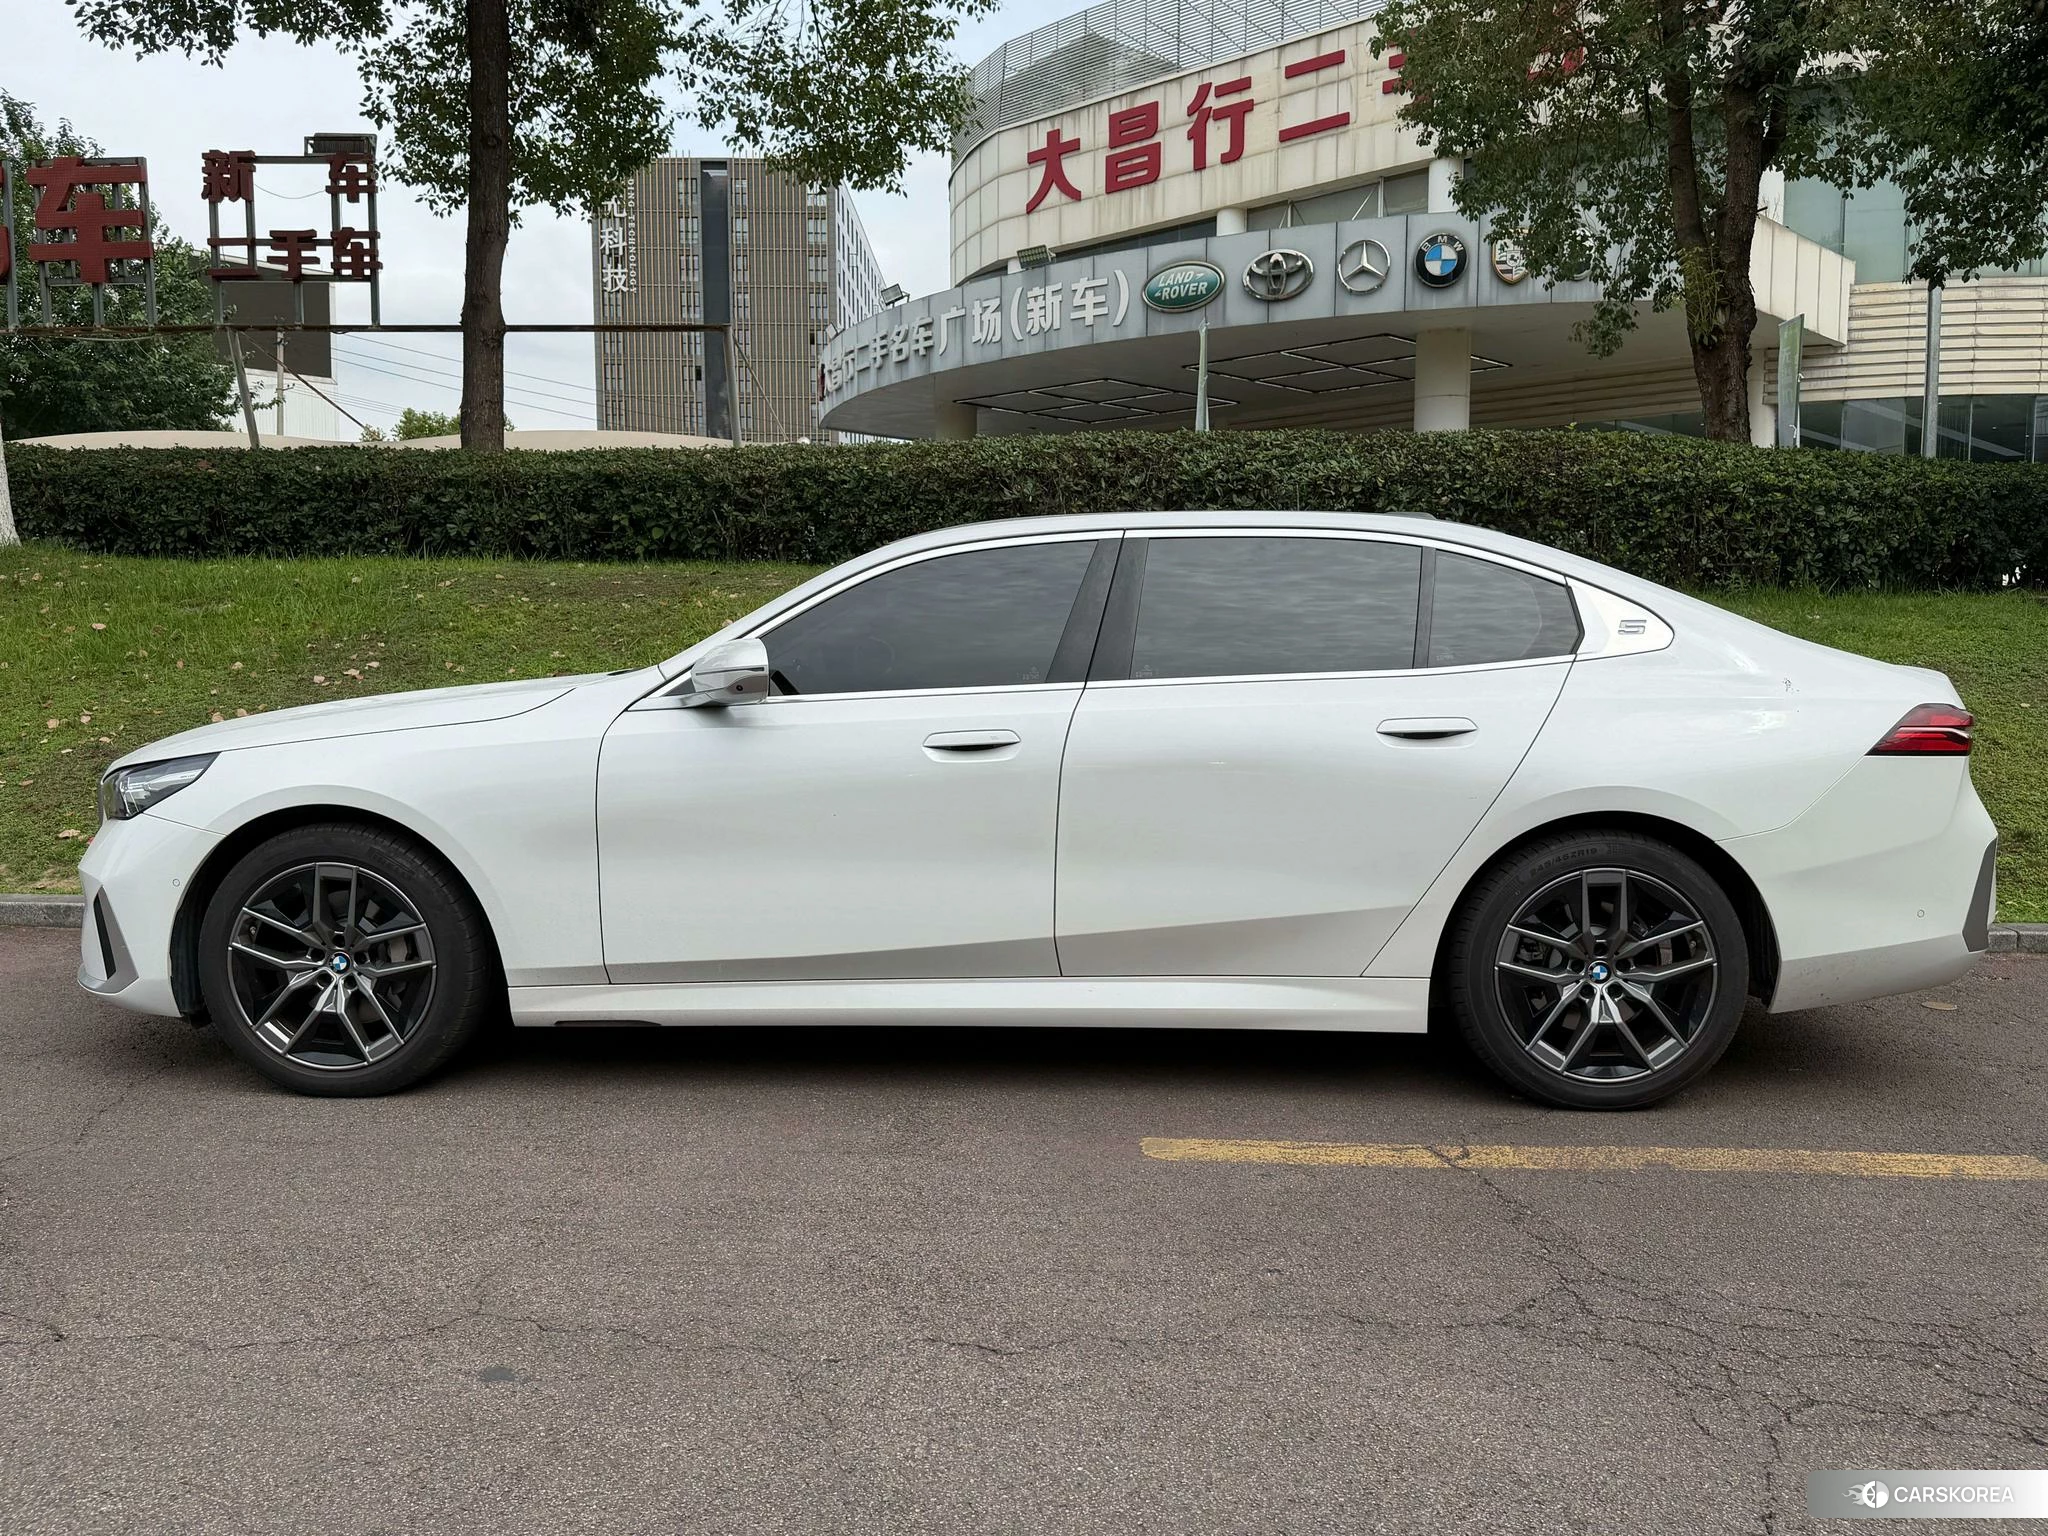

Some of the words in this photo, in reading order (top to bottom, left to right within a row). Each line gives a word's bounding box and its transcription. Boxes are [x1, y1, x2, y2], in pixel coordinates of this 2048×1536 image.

[0, 156, 153, 283] 车
[207, 227, 384, 280] 二手车
[1157, 269, 1196, 287] LAND
[1161, 280, 1208, 299] ROVER
